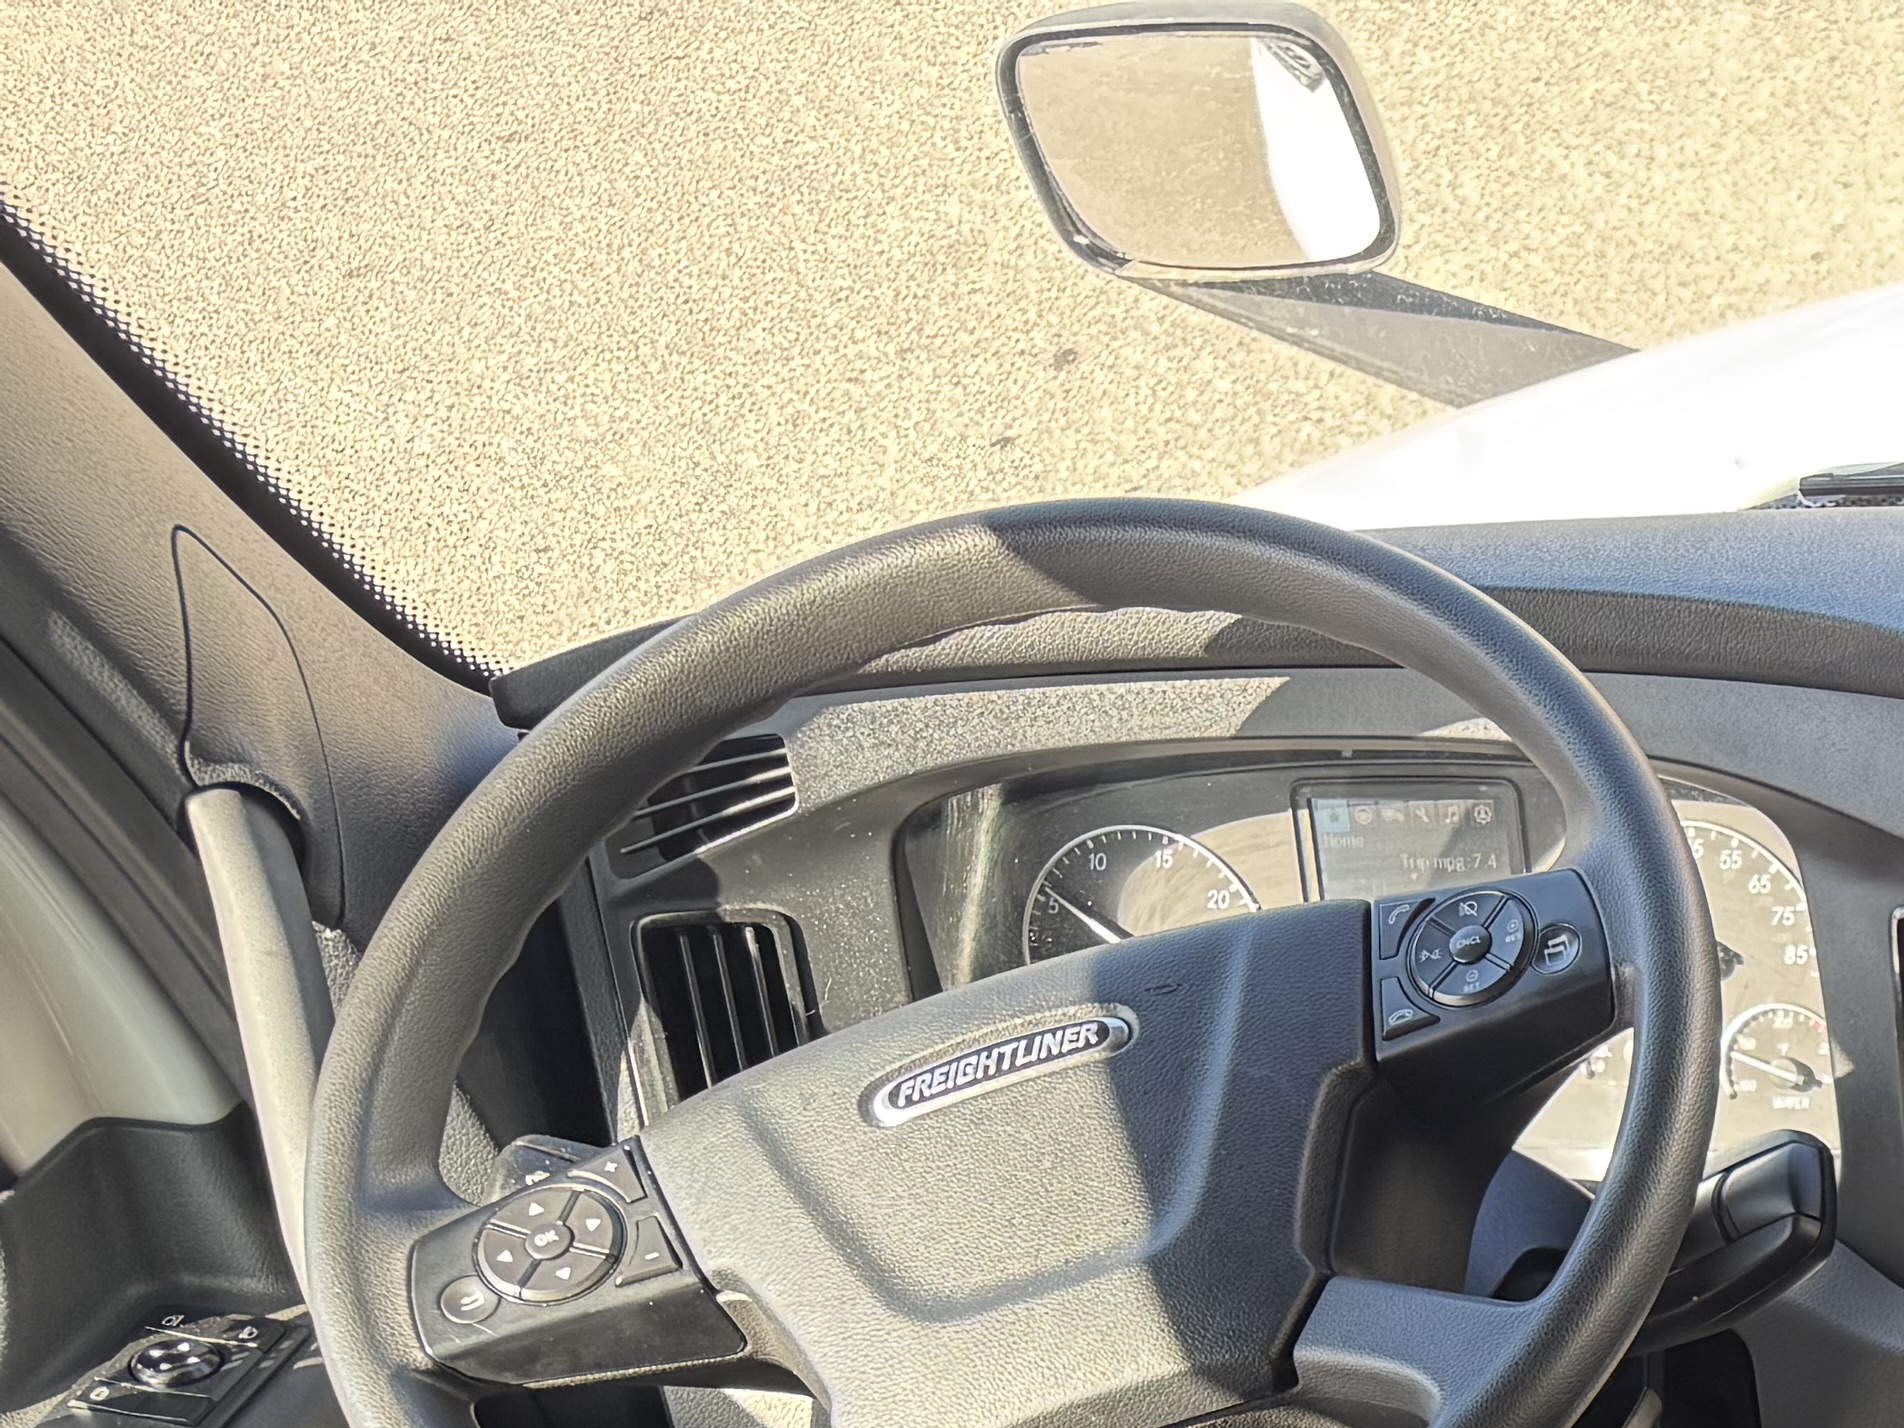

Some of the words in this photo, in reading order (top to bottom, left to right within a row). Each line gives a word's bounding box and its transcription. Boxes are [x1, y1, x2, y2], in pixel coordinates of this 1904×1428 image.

[1088, 852, 1107, 871] 10
[1155, 849, 1174, 869] 15
[1719, 850, 1743, 870] 55
[1748, 873, 1772, 895] 65
[1048, 896, 1059, 914] 5
[1207, 889, 1230, 909] 20
[1771, 906, 1796, 926] 75
[1784, 944, 1810, 966] 85
[896, 1021, 1101, 1107] FREIGHTLINER
[533, 1229, 560, 1247] OK
